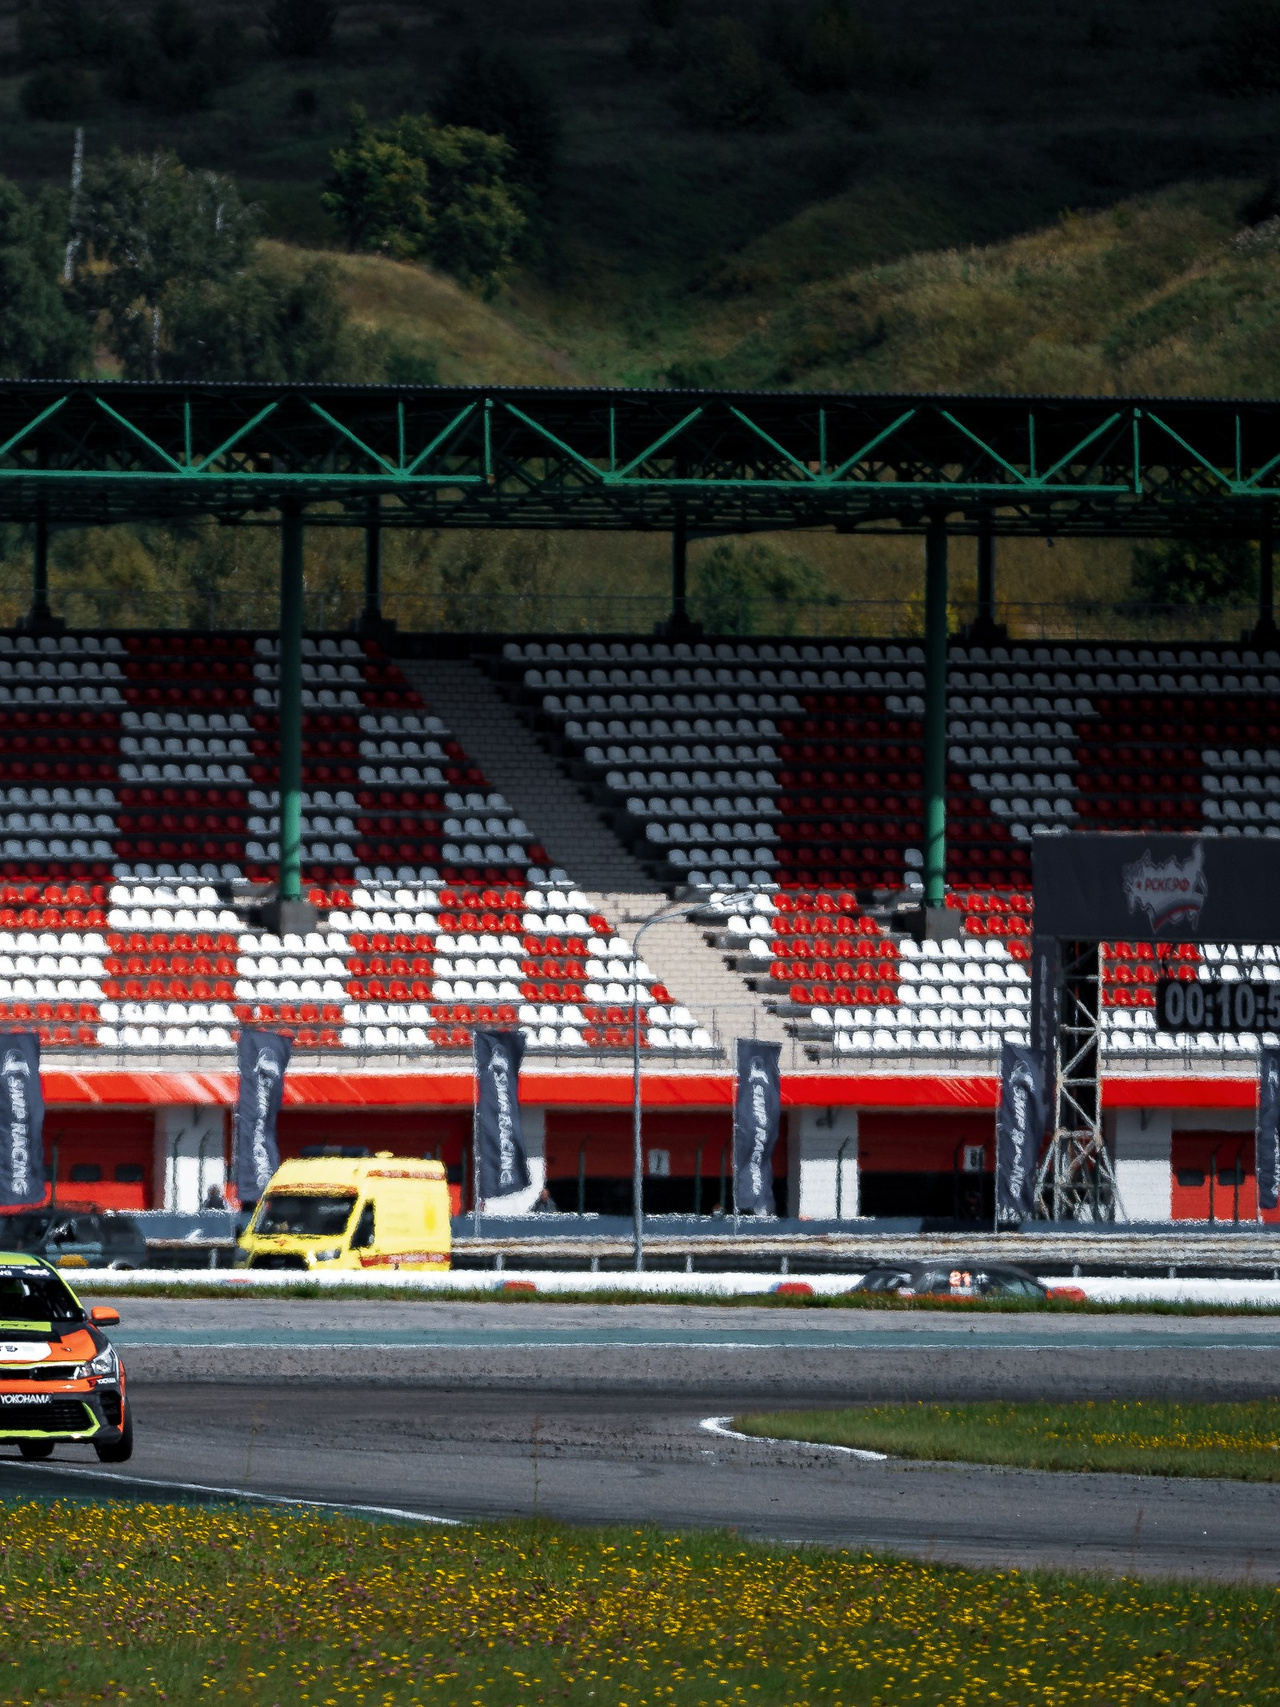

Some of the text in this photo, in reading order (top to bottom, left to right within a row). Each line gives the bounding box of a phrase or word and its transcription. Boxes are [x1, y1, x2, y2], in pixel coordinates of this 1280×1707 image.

[7, 1076, 31, 1195] SMP RACING
[497, 1113, 515, 1186] RACING
[0, 1394, 52, 1405] YOKOHAMA
